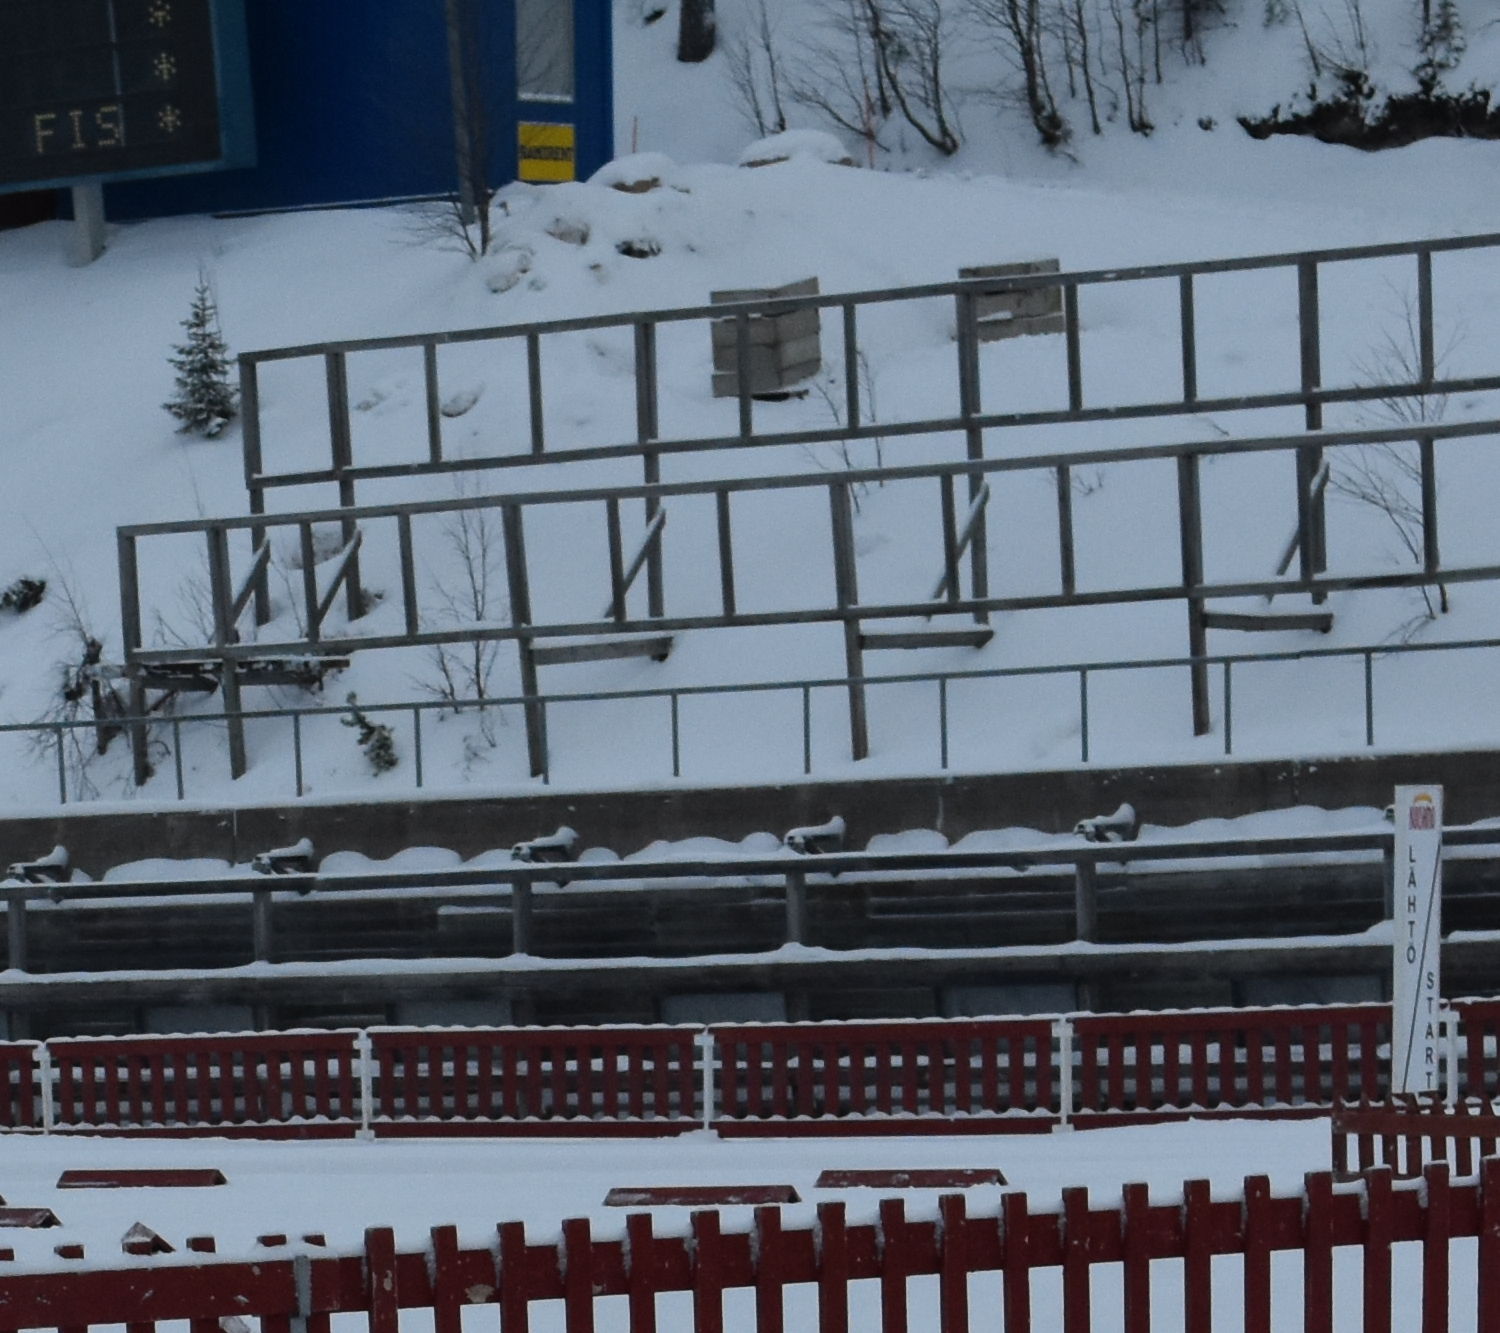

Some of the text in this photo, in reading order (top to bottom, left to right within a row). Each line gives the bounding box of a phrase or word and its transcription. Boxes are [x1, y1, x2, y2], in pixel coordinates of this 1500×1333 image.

[35, 106, 121, 154] FIS
[1406, 845, 1418, 964] LÄHTÖ
[1425, 971, 1435, 1090] START
